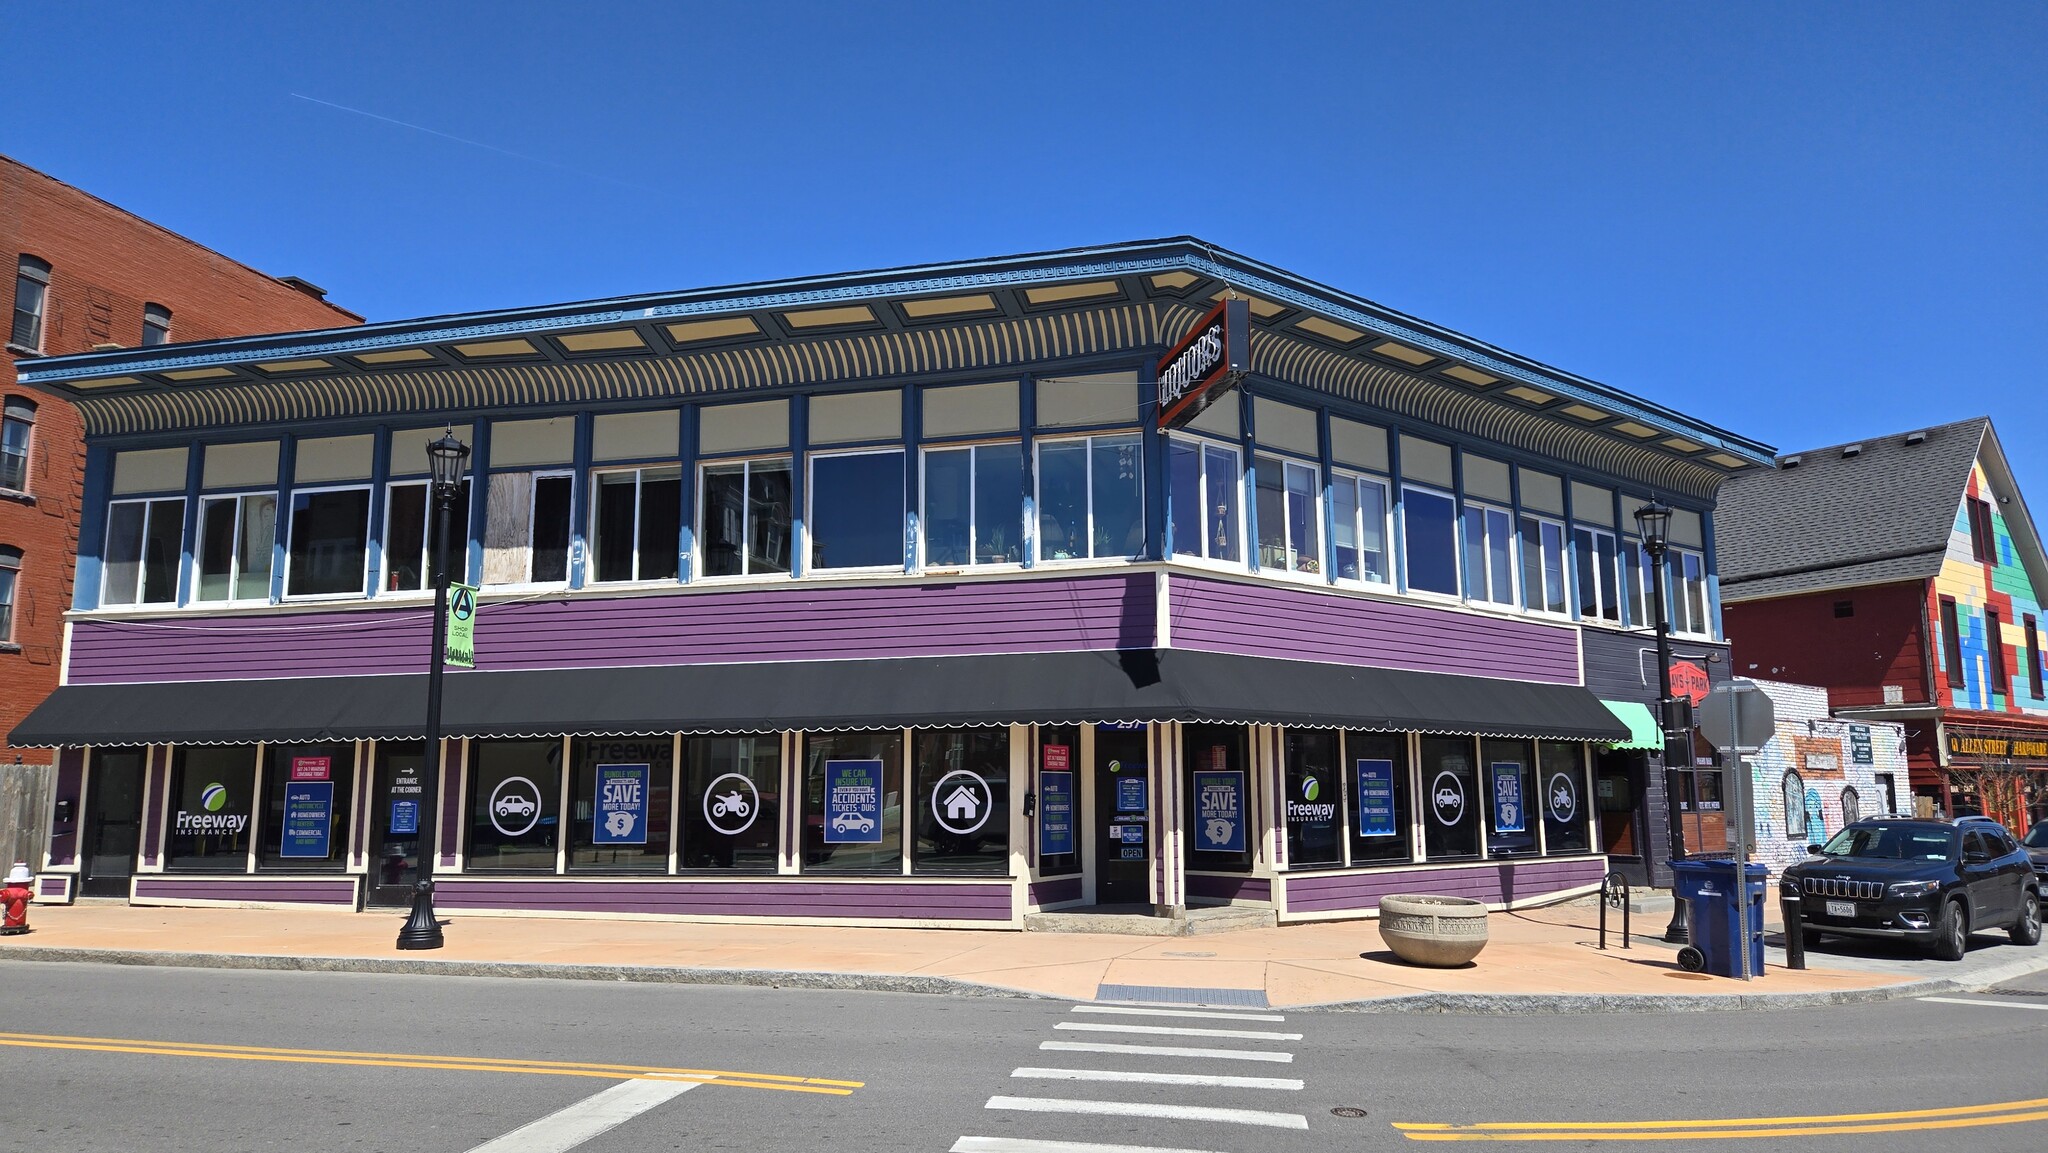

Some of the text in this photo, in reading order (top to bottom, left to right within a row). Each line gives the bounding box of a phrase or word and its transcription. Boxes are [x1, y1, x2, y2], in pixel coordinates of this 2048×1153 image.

[1158, 325, 1222, 407] LIQUORS
[452, 631, 469, 639] LOCAL
[1671, 673, 1708, 692] AYS PARK
[586, 741, 673, 760] Freewa
[1960, 738, 2048, 756] ALLEN STREET HARDWARE
[604, 770, 642, 778] BUNDLE YOUR
[842, 769, 867, 778] WE CAN
[396, 777, 418, 785] ENTRANCE
[835, 777, 873, 786] INSURE YOU
[390, 786, 422, 794] AT THE CORNER
[1497, 780, 1519, 796] SAVE
[603, 784, 641, 803] SAVE
[832, 793, 876, 804] ACCIDENTS
[602, 802, 641, 811] MORE TODAY!
[1201, 792, 1237, 811] SAVE
[832, 803, 876, 812] TICKETS DUIs
[1287, 800, 1335, 819] Freeway
[1201, 810, 1238, 819] MORE TODAY!
[176, 810, 248, 833] Freeway
[1123, 849, 1142, 858] OPEN
